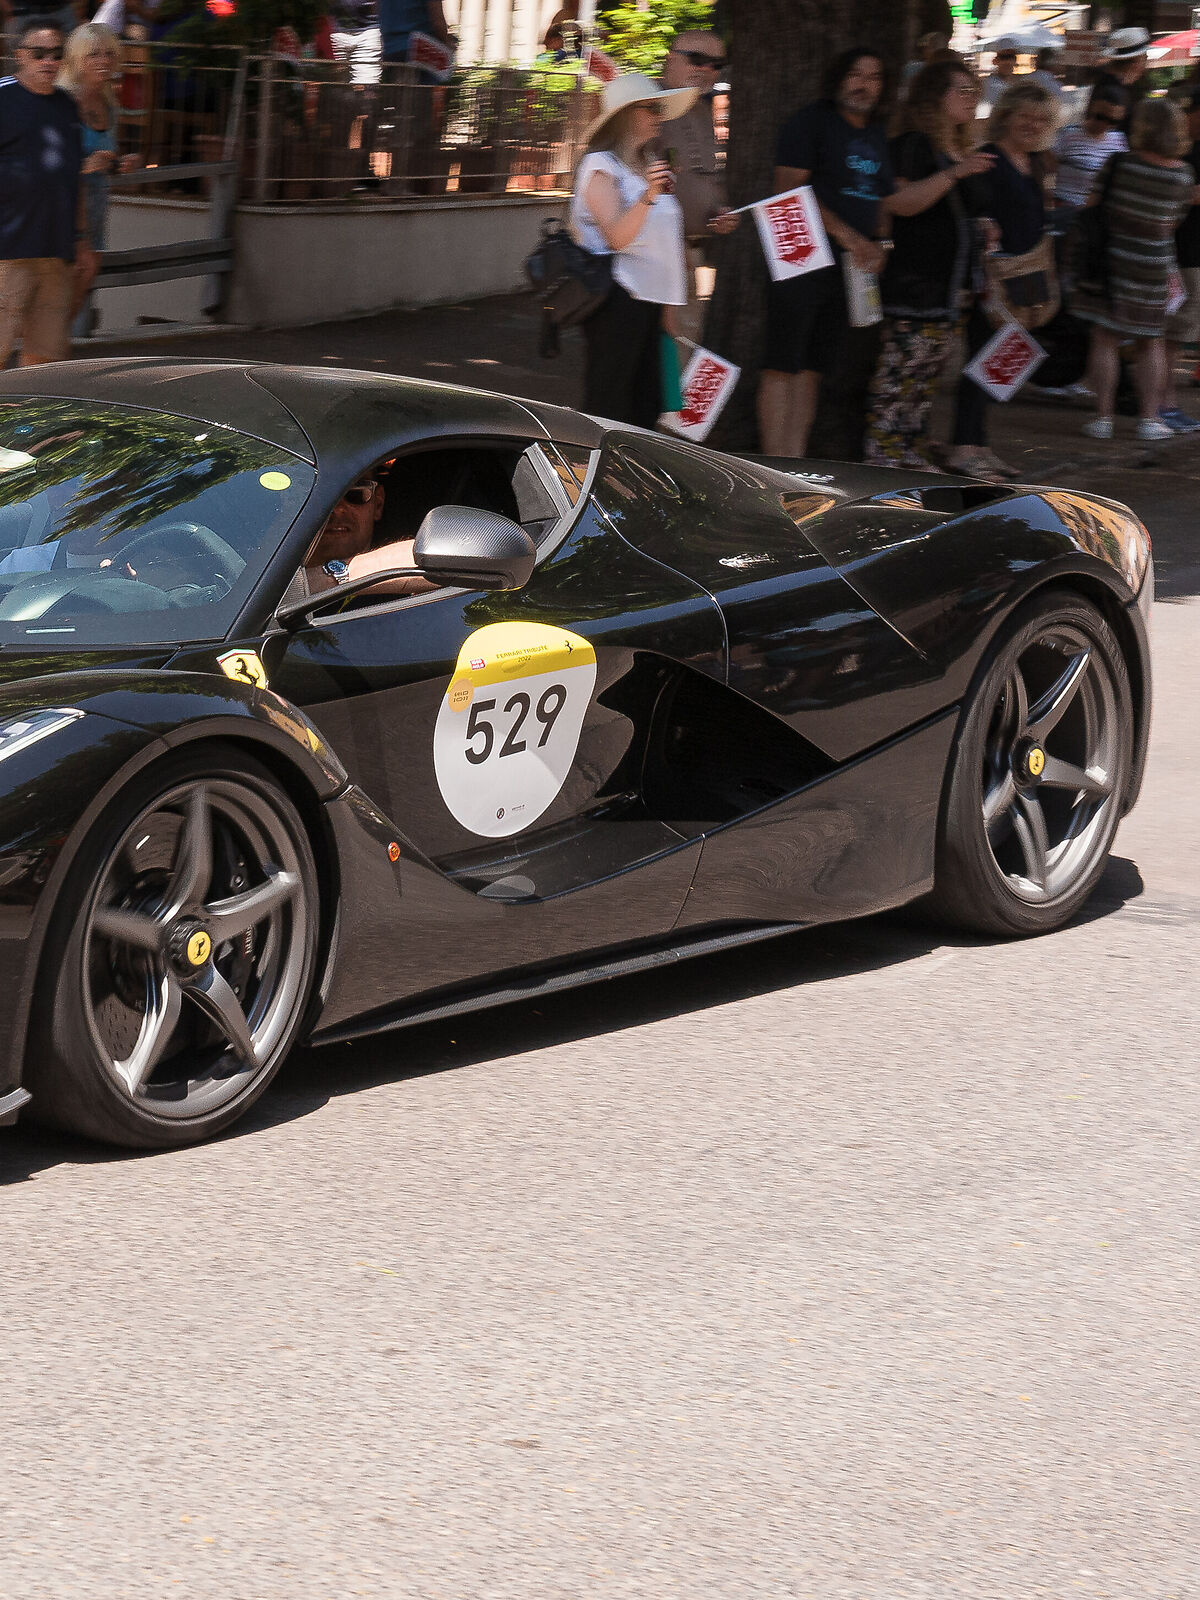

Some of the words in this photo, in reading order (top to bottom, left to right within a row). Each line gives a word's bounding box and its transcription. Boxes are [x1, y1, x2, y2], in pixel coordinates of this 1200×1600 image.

[496, 649, 522, 659] FERRARI
[523, 644, 548, 656] TRIBUTE
[464, 684, 568, 765] 529
